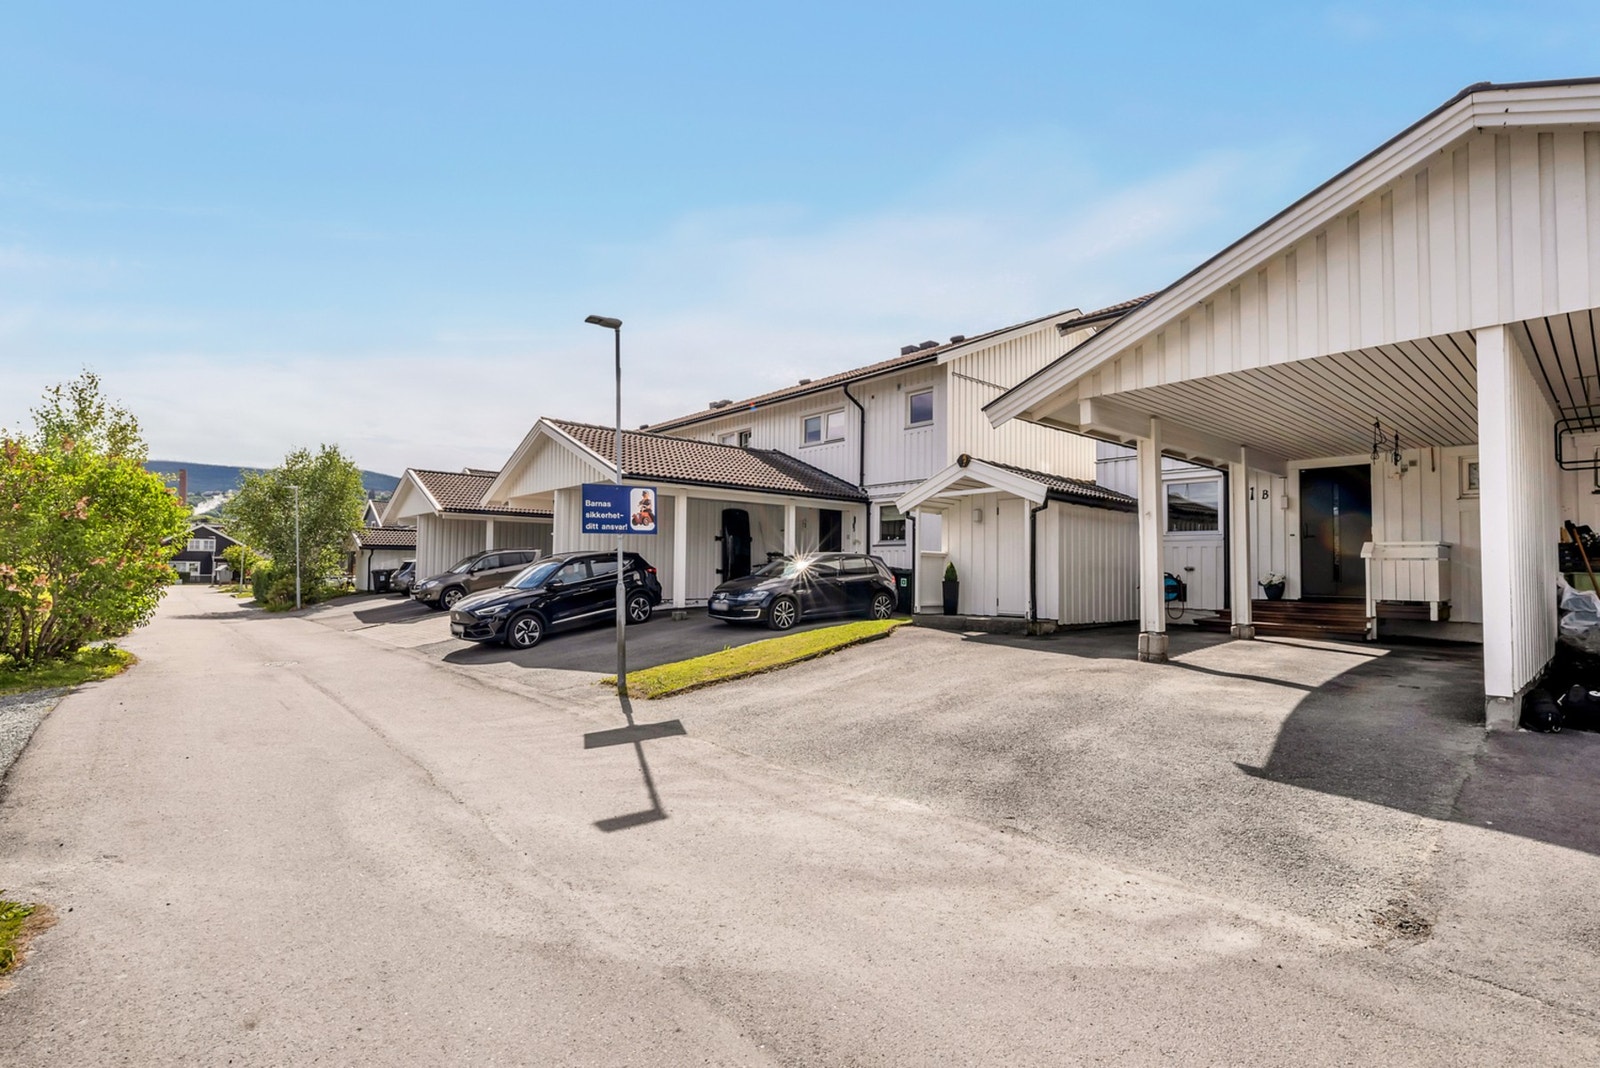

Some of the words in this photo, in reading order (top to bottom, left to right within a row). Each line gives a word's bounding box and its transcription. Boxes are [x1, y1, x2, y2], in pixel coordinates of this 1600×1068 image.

[1250, 487, 1255, 500] 1
[1262, 489, 1269, 500] B
[585, 499, 611, 507] Barnas
[585, 511, 624, 519] sikkerhet-
[601, 523, 628, 531] ansvar!
